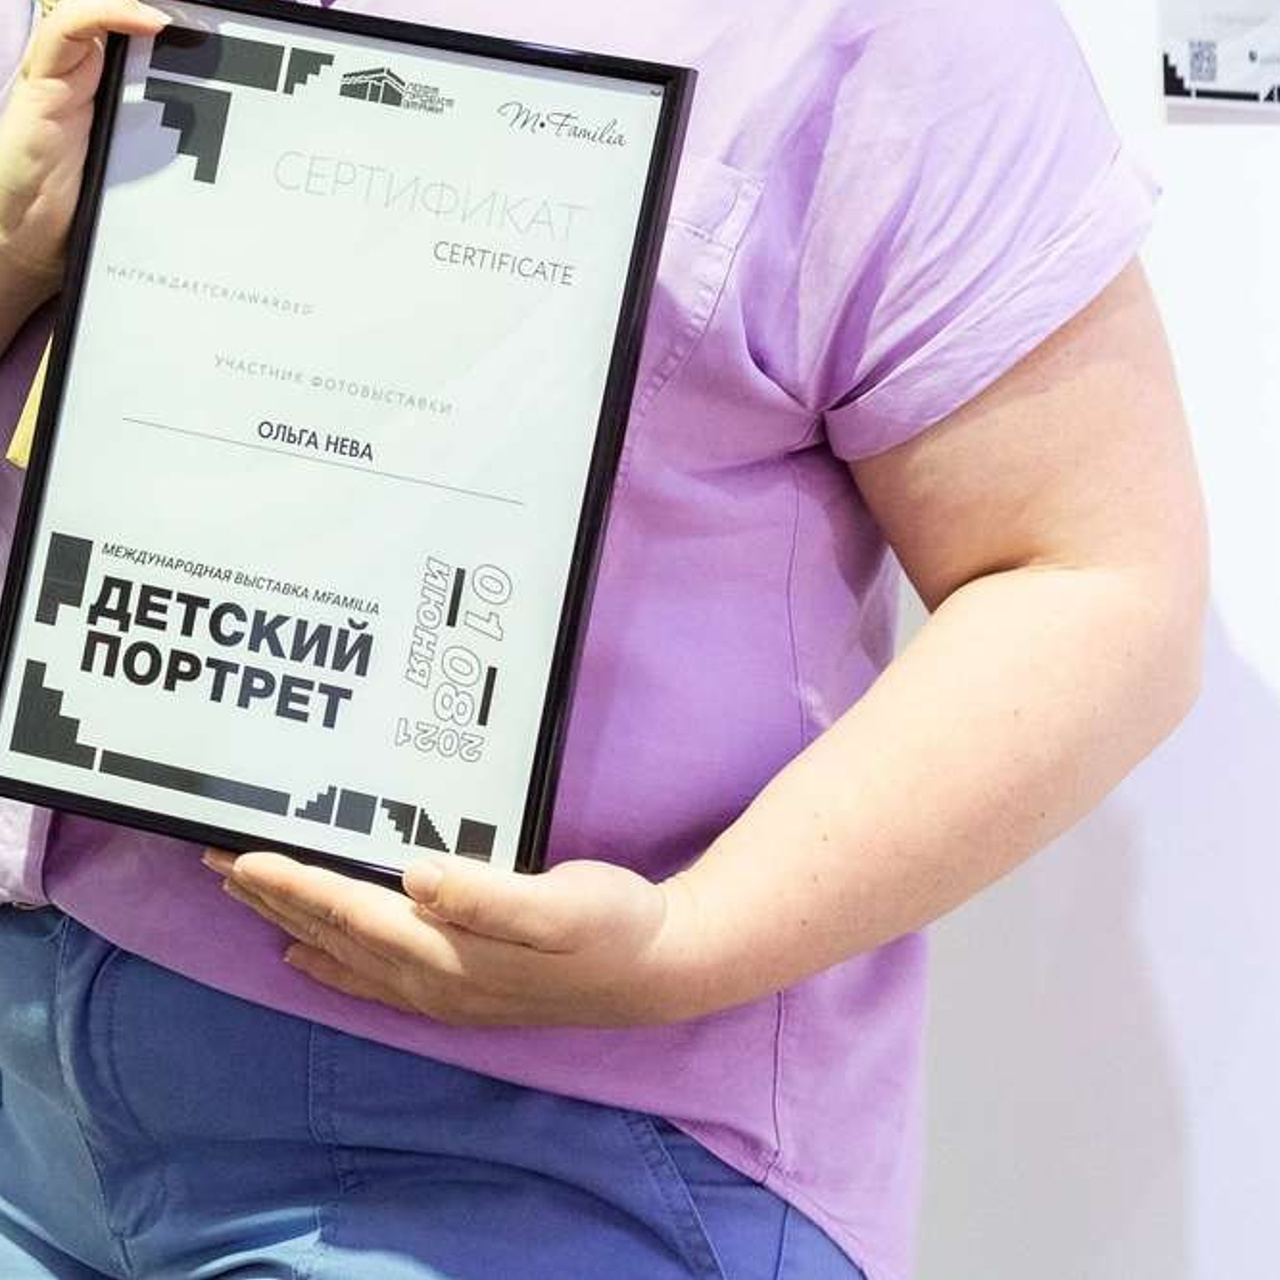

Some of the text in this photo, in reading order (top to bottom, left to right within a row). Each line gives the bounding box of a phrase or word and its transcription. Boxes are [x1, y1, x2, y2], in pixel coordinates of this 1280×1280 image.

[274, 150, 588, 241] СЕРТИФИКАТ
[433, 240, 577, 286] CERTIFICATE
[215, 353, 454, 415] УЧАСТНИК ФОТОВЫСТАВКИ
[258, 420, 374, 462] ОЛЬГА НЕВА
[101, 542, 380, 615] МЕЖДУНАРОДНАЯ ВЫСТАВКА MFAMILIA
[87, 575, 374, 677] ДЕТСКИЙ
[405, 556, 451, 688] ИЮНЯ
[433, 563, 513, 726] 01 08
[80, 629, 354, 729] ПОРТРЕТ
[395, 717, 485, 762] 2021
